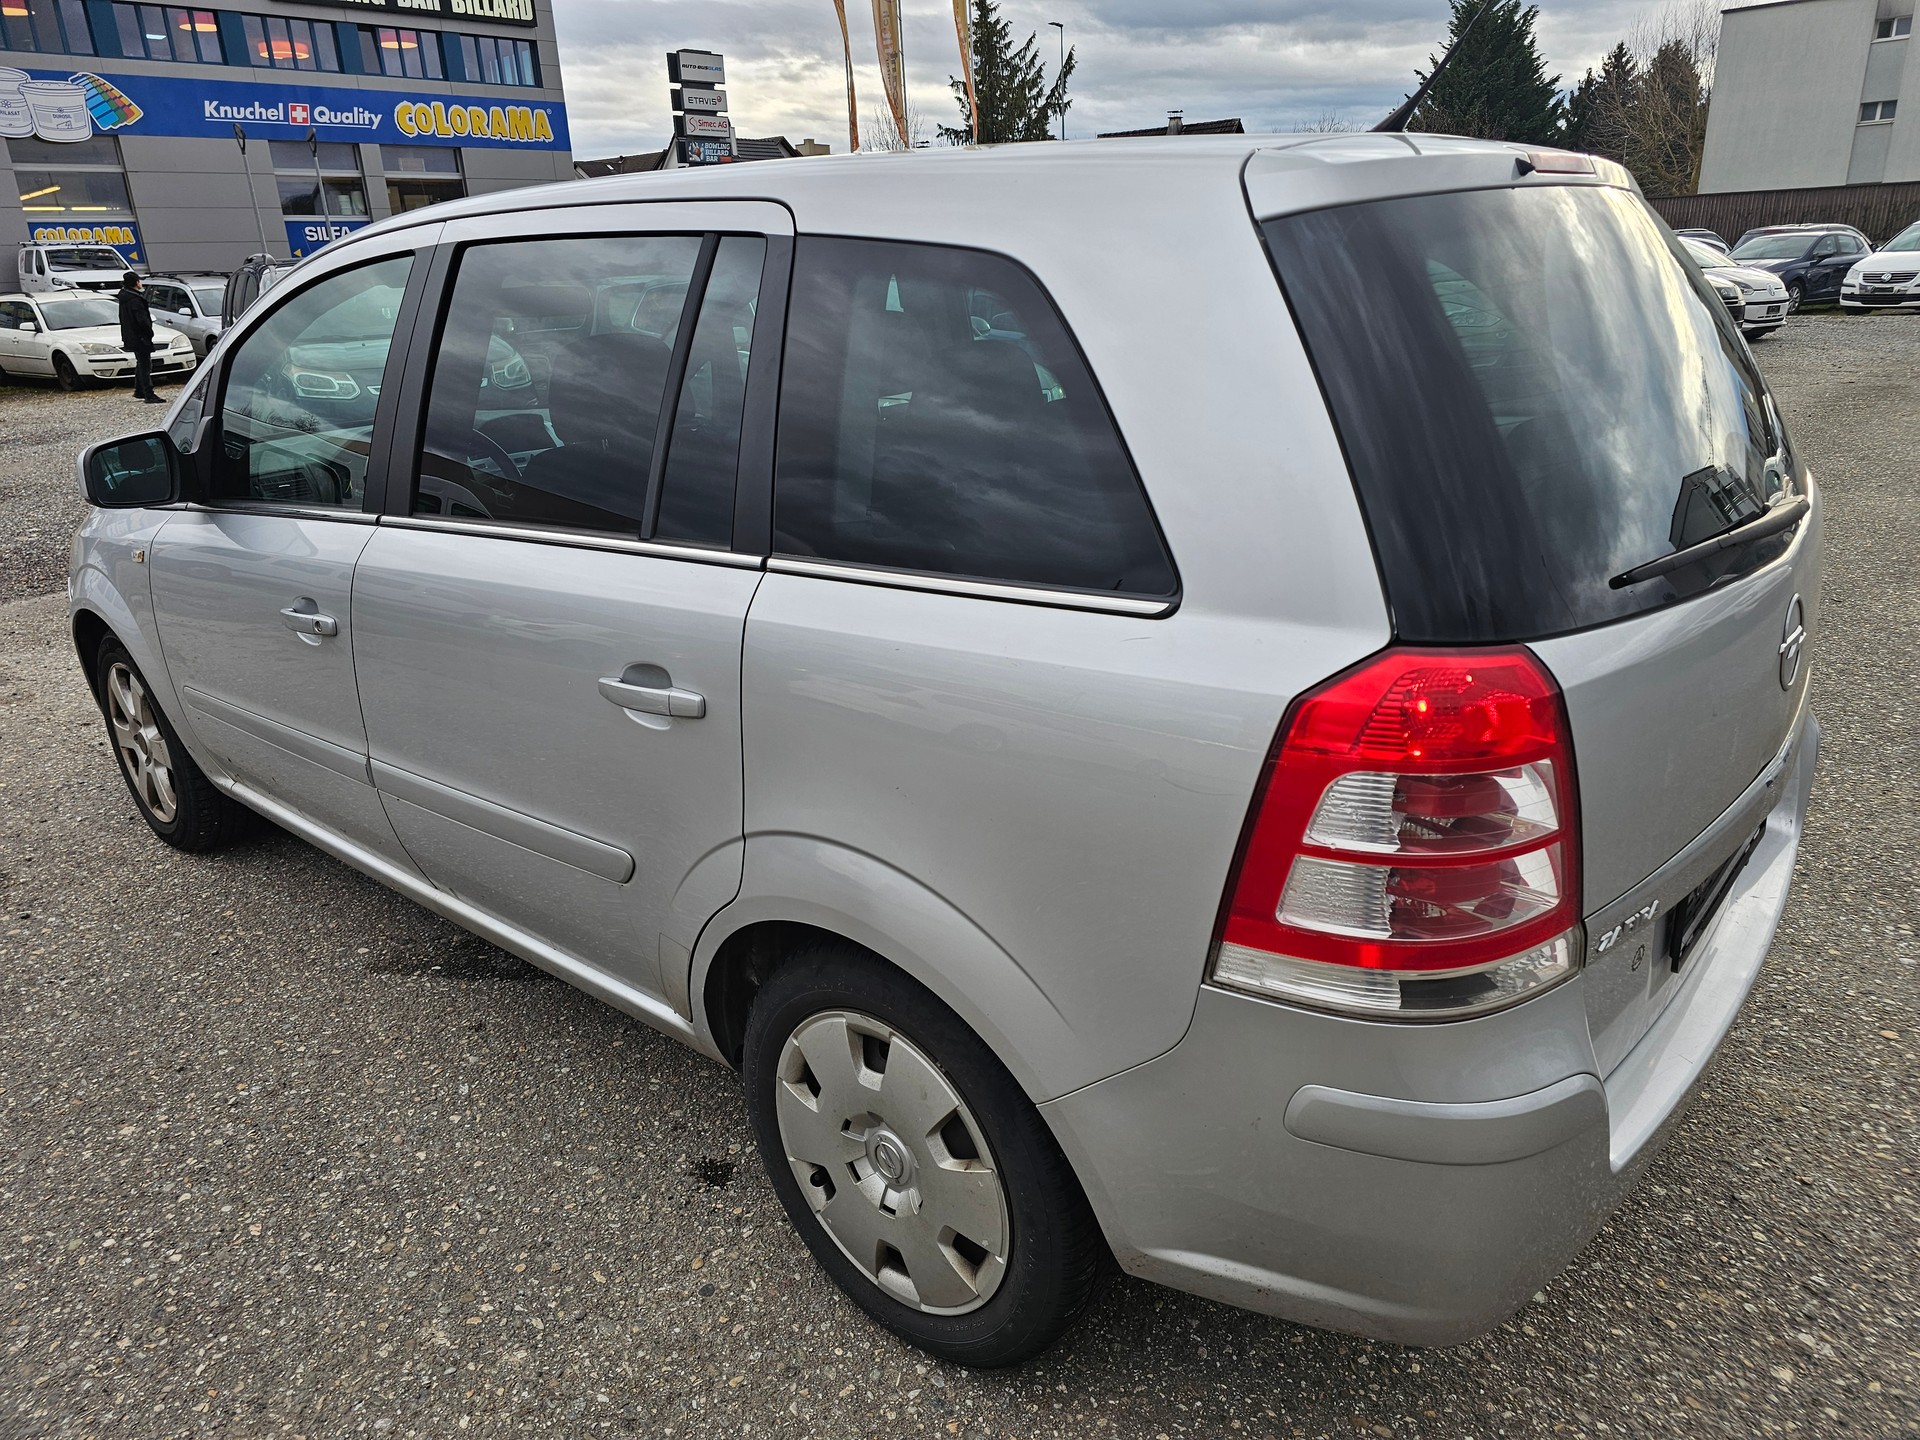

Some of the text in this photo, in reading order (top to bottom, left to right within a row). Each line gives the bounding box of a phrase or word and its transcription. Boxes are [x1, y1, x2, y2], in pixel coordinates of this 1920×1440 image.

[451, 0, 533, 21] BILLARD
[688, 97, 718, 106] ETAVIS
[204, 100, 382, 129] Knuchel Quality
[698, 119, 728, 129] Simec AG
[704, 142, 731, 150] BOWLING
